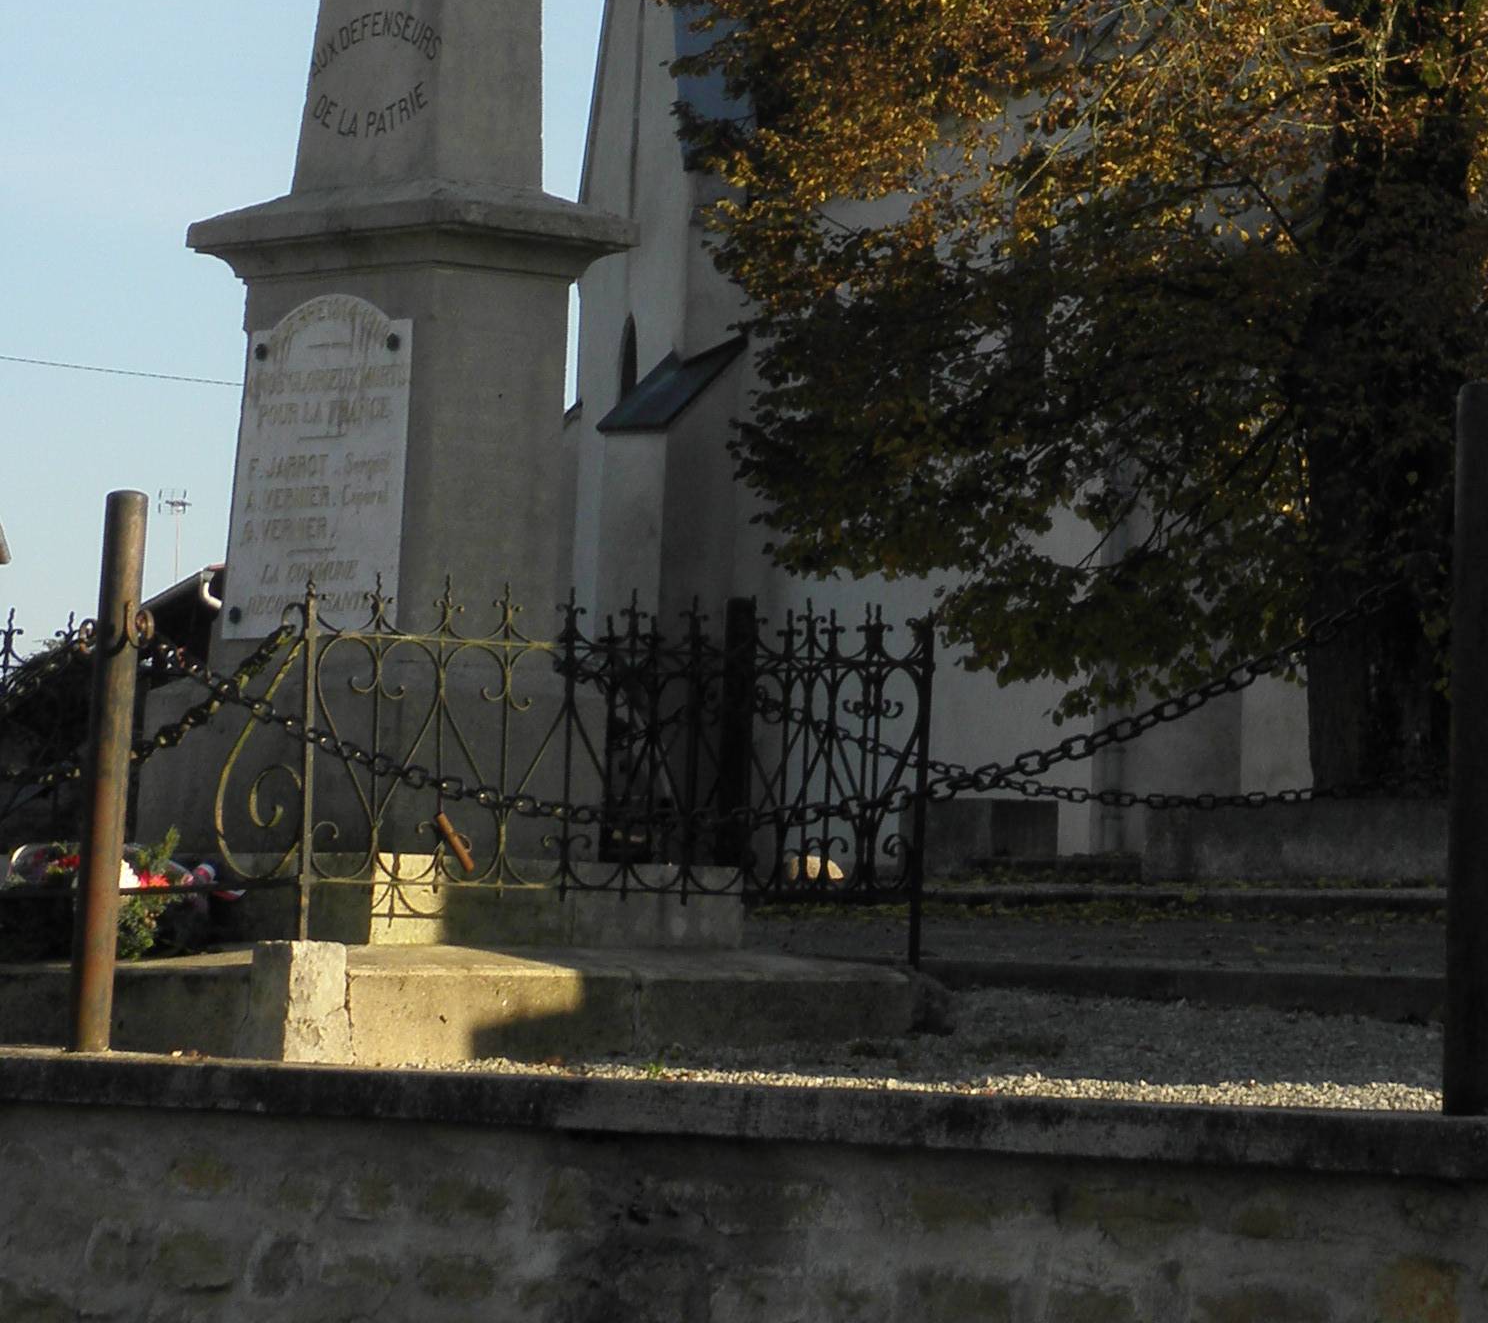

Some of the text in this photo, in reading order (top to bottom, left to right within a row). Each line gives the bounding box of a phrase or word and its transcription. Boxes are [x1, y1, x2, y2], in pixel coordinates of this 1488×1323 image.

[338, 9, 442, 61] DEFENSEURS
[312, 81, 428, 138] DE LA PATRIE
